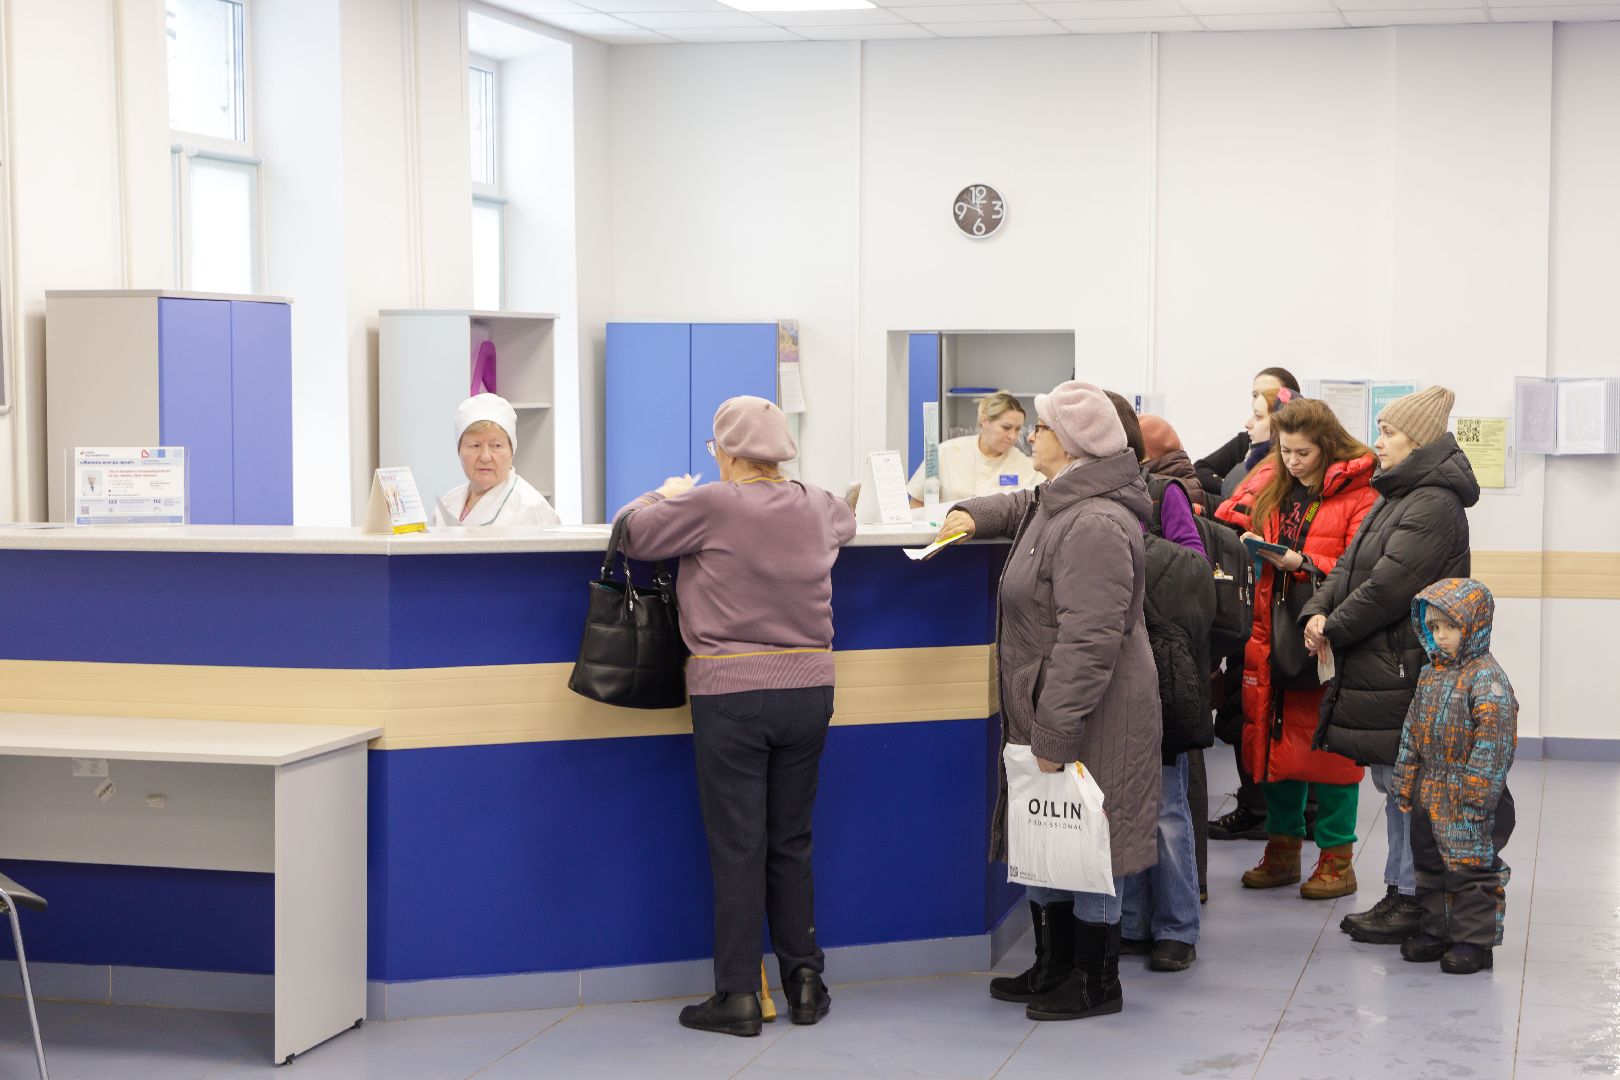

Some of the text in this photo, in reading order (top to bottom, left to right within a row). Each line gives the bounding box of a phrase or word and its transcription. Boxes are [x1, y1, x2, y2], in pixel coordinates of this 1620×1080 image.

[969, 186, 987, 204] 12
[955, 200, 1003, 220] 9 3
[973, 217, 986, 236] 6
